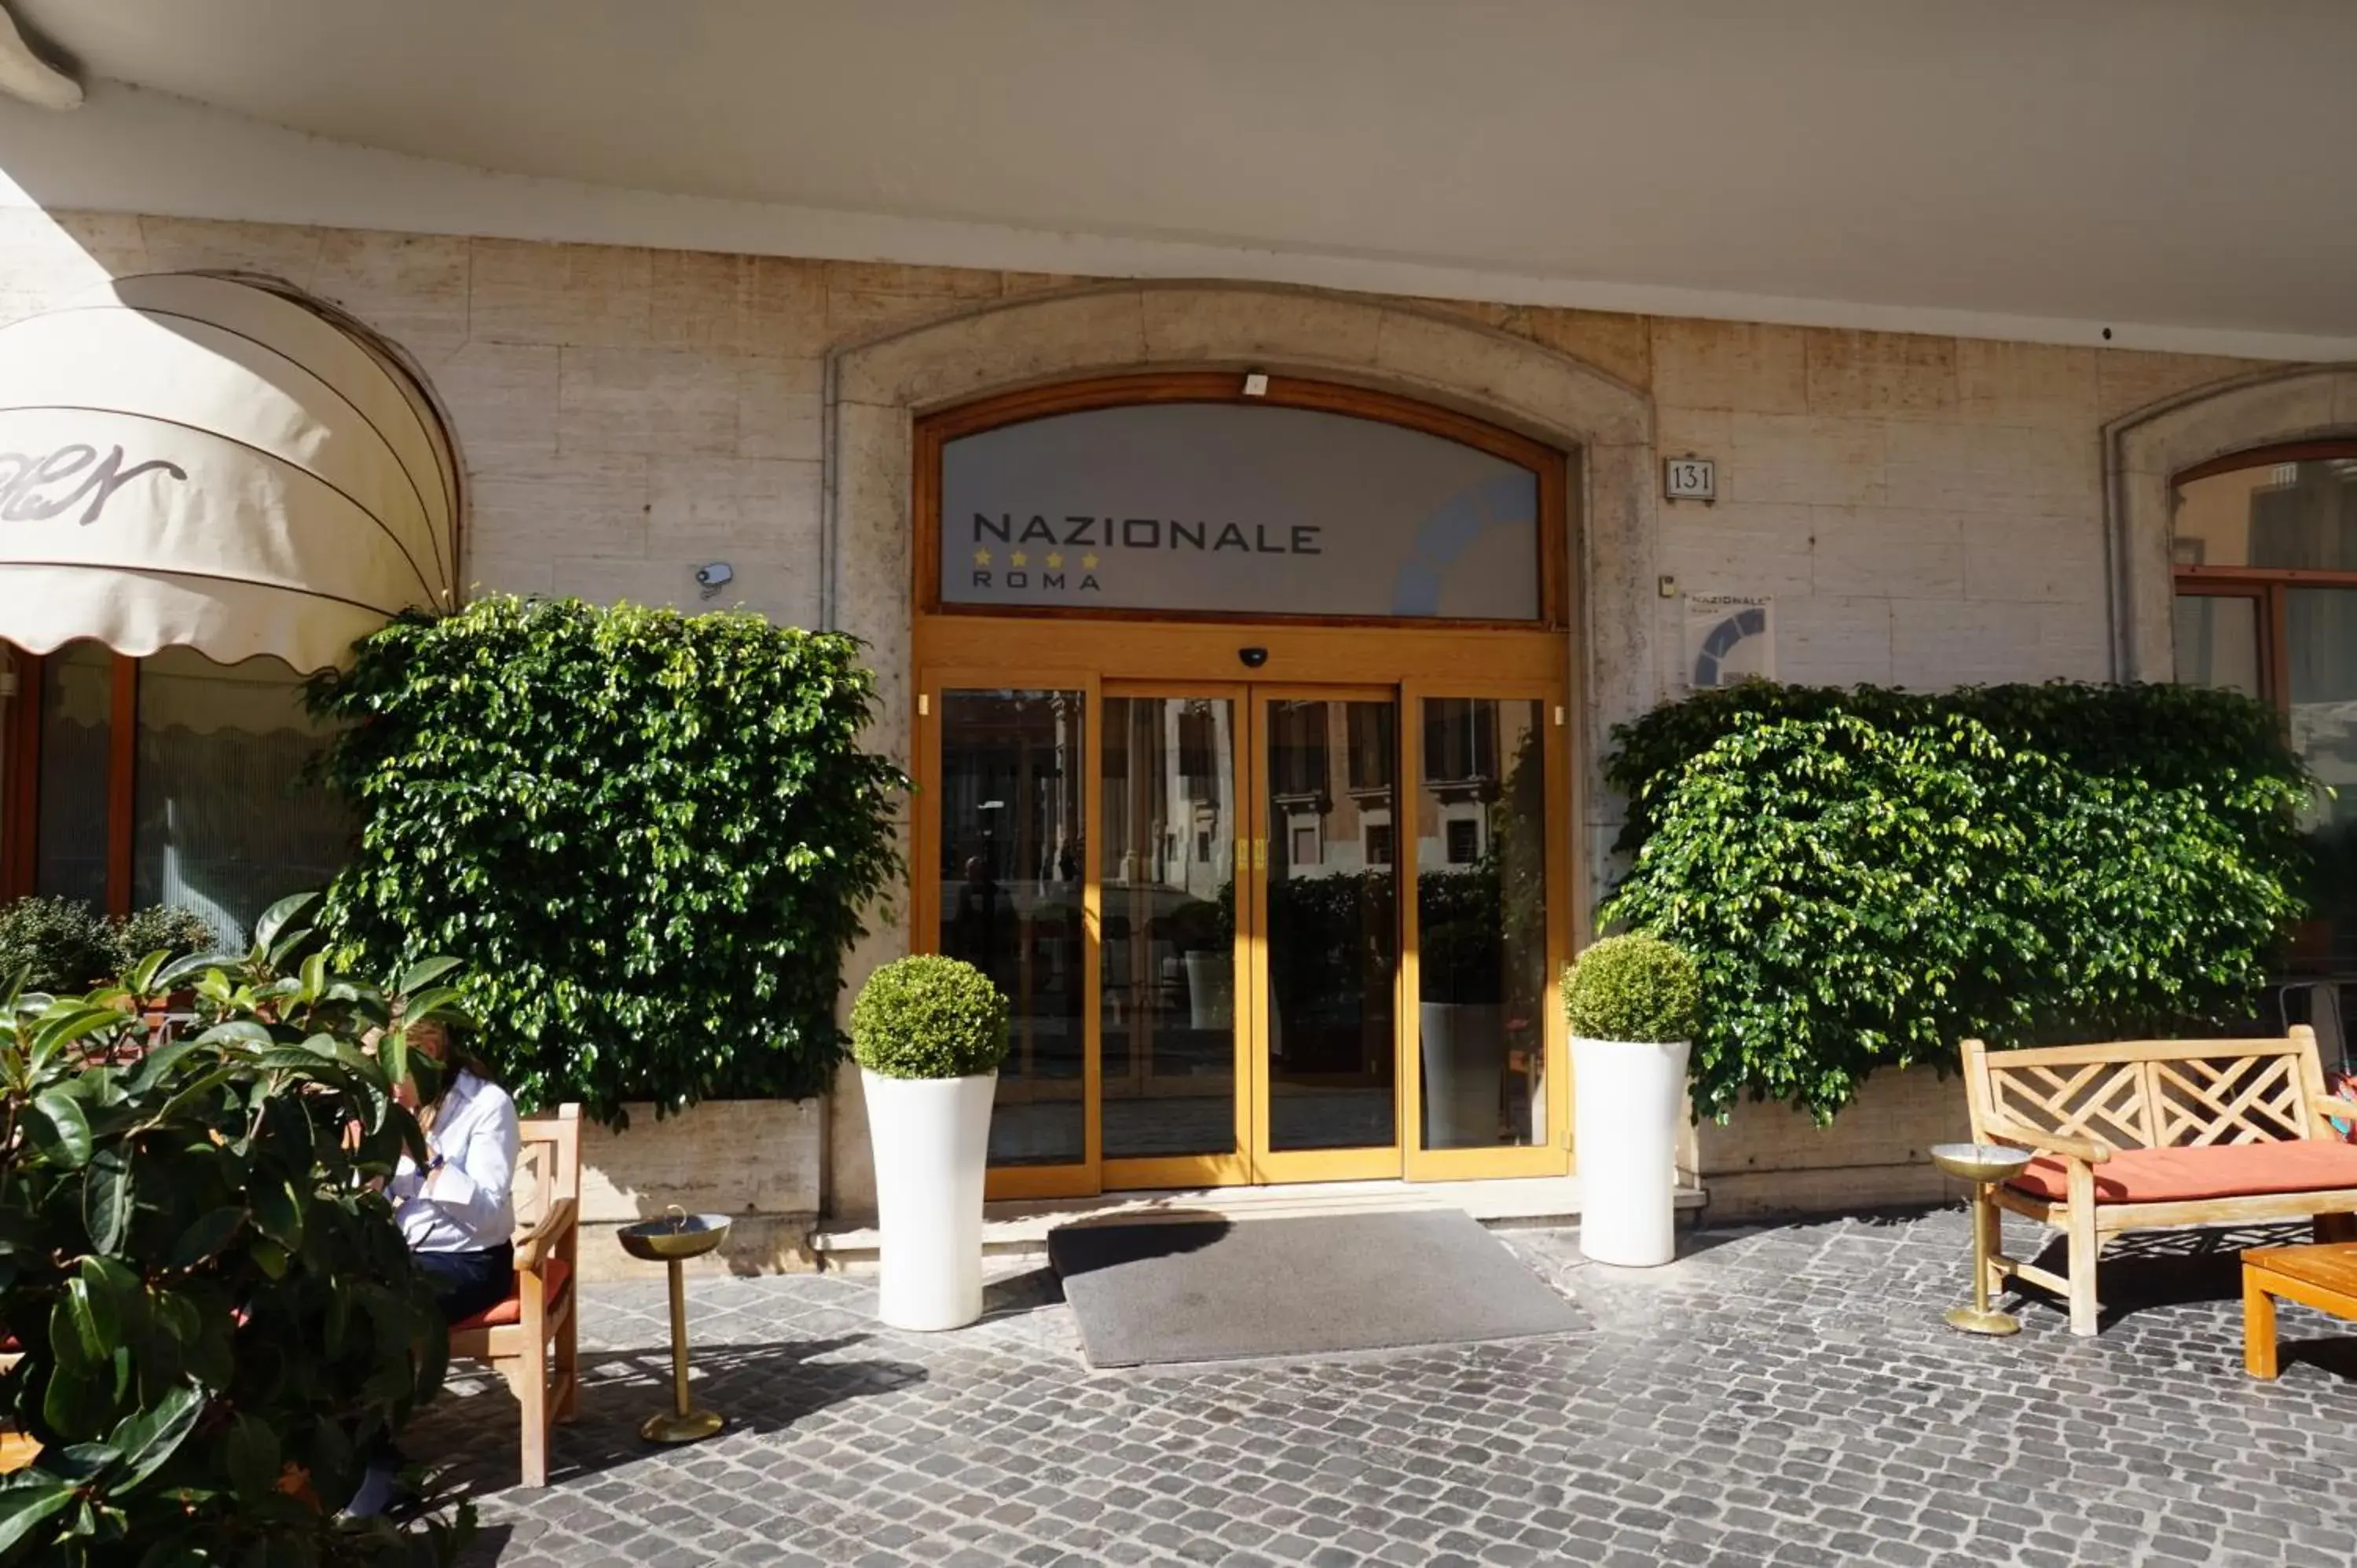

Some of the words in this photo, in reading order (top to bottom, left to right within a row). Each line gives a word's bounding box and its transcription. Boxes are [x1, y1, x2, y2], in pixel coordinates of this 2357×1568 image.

[1674, 464, 1708, 489] 131
[973, 512, 1322, 555] NAZIONALE
[972, 570, 1102, 592] ROMA
